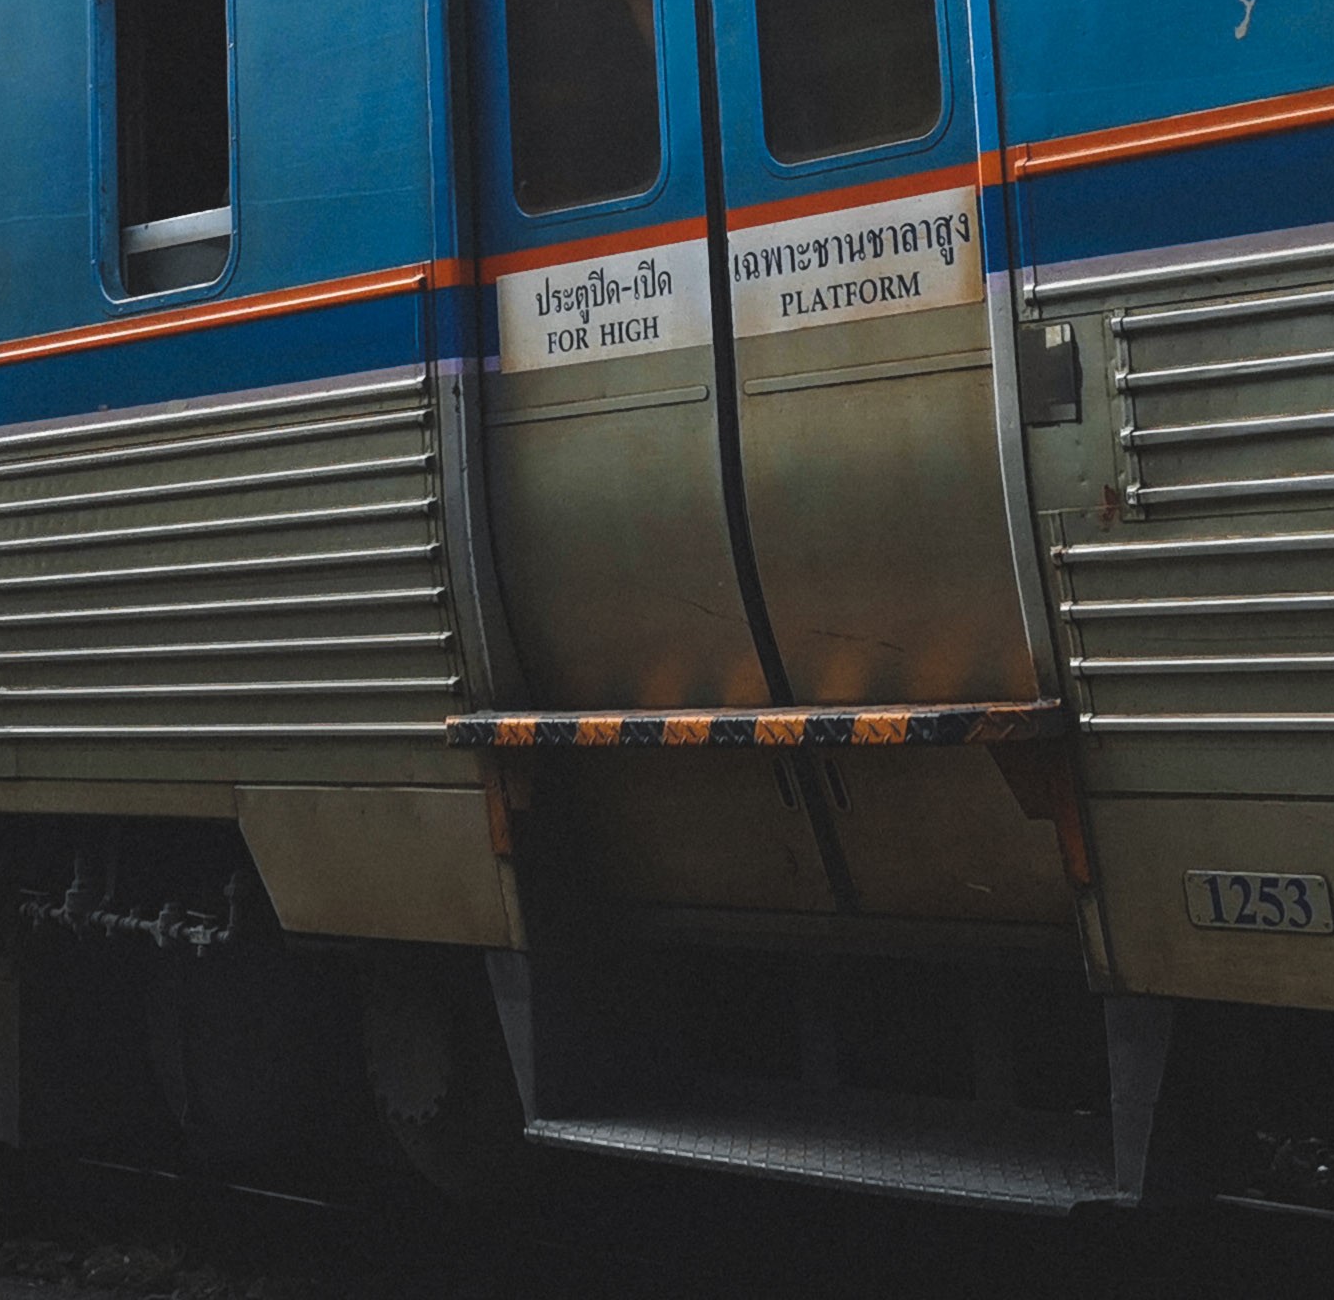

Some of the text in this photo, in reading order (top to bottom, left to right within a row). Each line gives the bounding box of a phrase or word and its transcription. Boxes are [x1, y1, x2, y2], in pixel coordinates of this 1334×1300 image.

[733, 212, 971, 282] เฉพาะชานชาลาสูง
[535, 257, 673, 325] ประตูปิด-เปิด
[780, 271, 922, 317] PLATFORM
[547, 315, 660, 355] FOR HIGH
[1202, 874, 1314, 928] 1253
